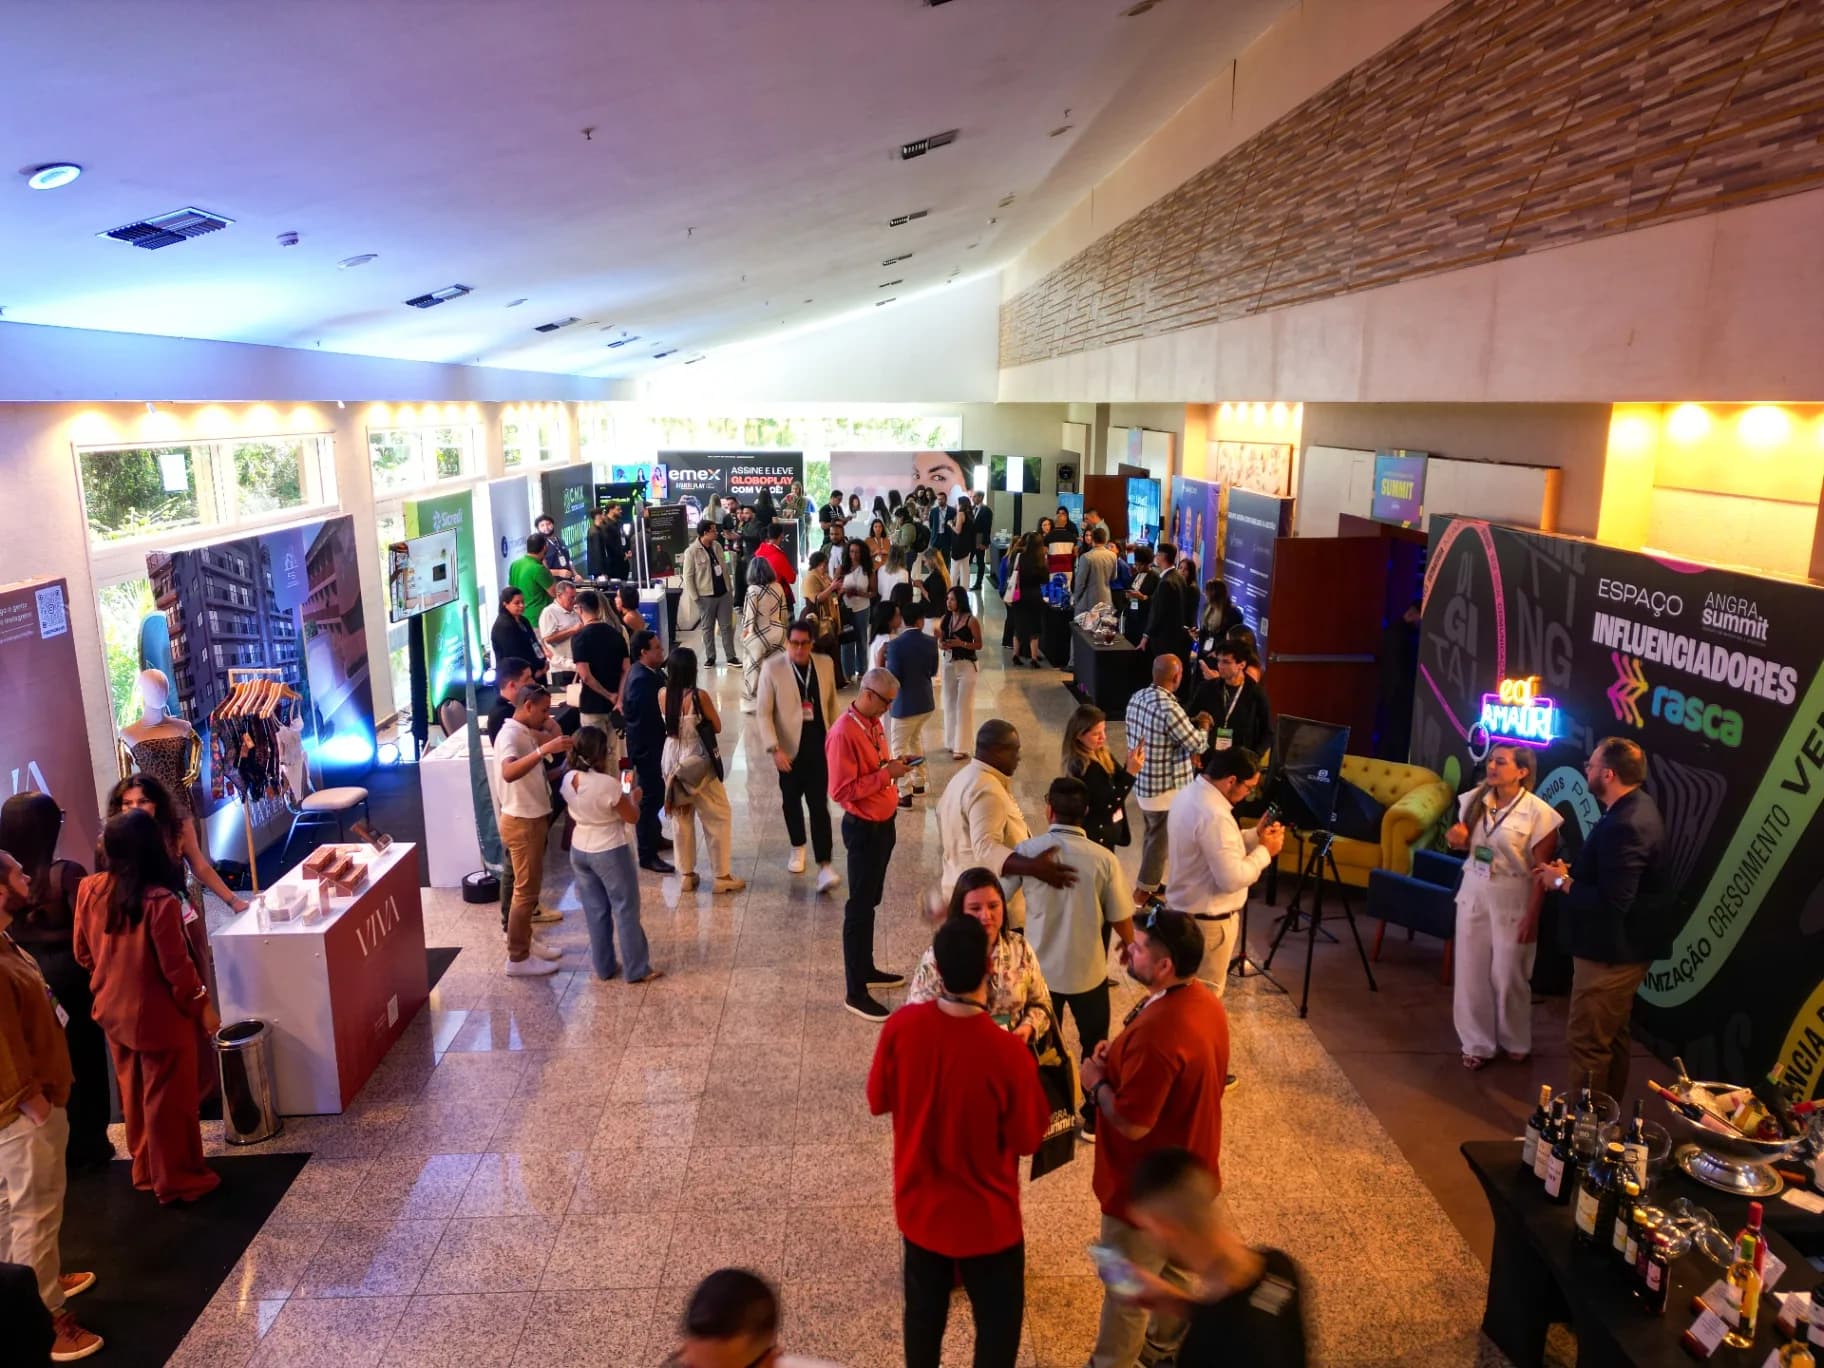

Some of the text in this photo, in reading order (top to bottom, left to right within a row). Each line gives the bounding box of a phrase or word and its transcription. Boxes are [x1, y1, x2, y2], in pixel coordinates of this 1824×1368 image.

[668, 468, 721, 481] emex
[731, 466, 794, 475] ASSINE E LEVE
[731, 476, 793, 485] GLOBOPLAY
[1381, 478, 1414, 500] SUMMIT
[731, 486, 753, 494] COM
[1598, 577, 1684, 617] ESPAÇO
[1704, 591, 1758, 619] ANGRA
[1702, 607, 1769, 641] summit
[1592, 611, 1798, 705] INFLUENCIADORES
[1652, 685, 1744, 748] rasca
[1780, 711, 1824, 795] VE
[1707, 803, 1791, 939] CRESCIMENTO
[356, 894, 400, 956] VIVA
[1644, 937, 1712, 993] NIZAÇÃO
